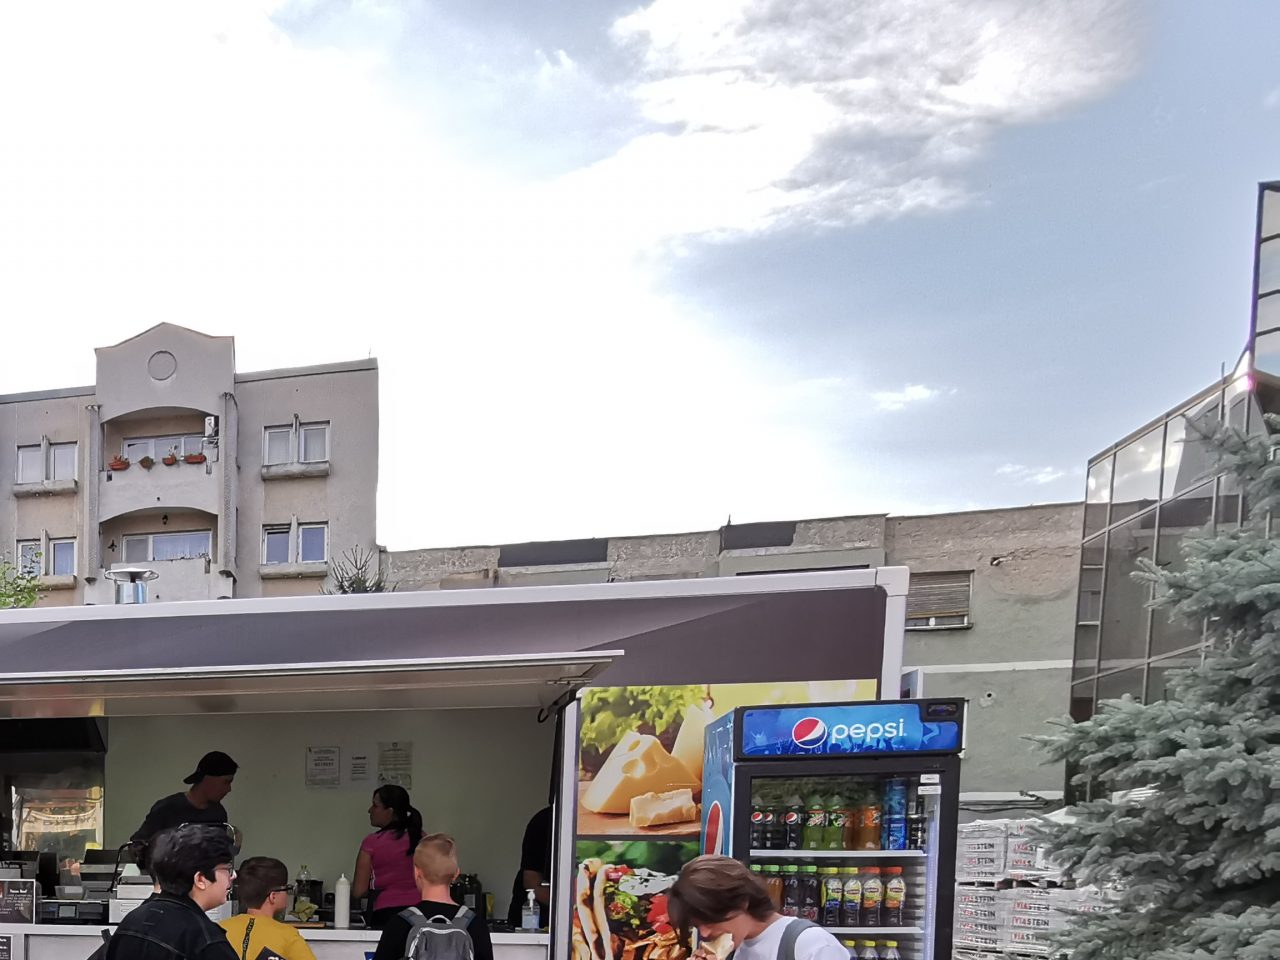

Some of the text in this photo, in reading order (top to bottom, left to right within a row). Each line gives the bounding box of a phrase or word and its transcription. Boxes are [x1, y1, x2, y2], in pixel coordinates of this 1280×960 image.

[831, 718, 905, 744] pepsi
[1016, 917, 1049, 927] VIASTEIN
[1014, 933, 1037, 942] VIAST
